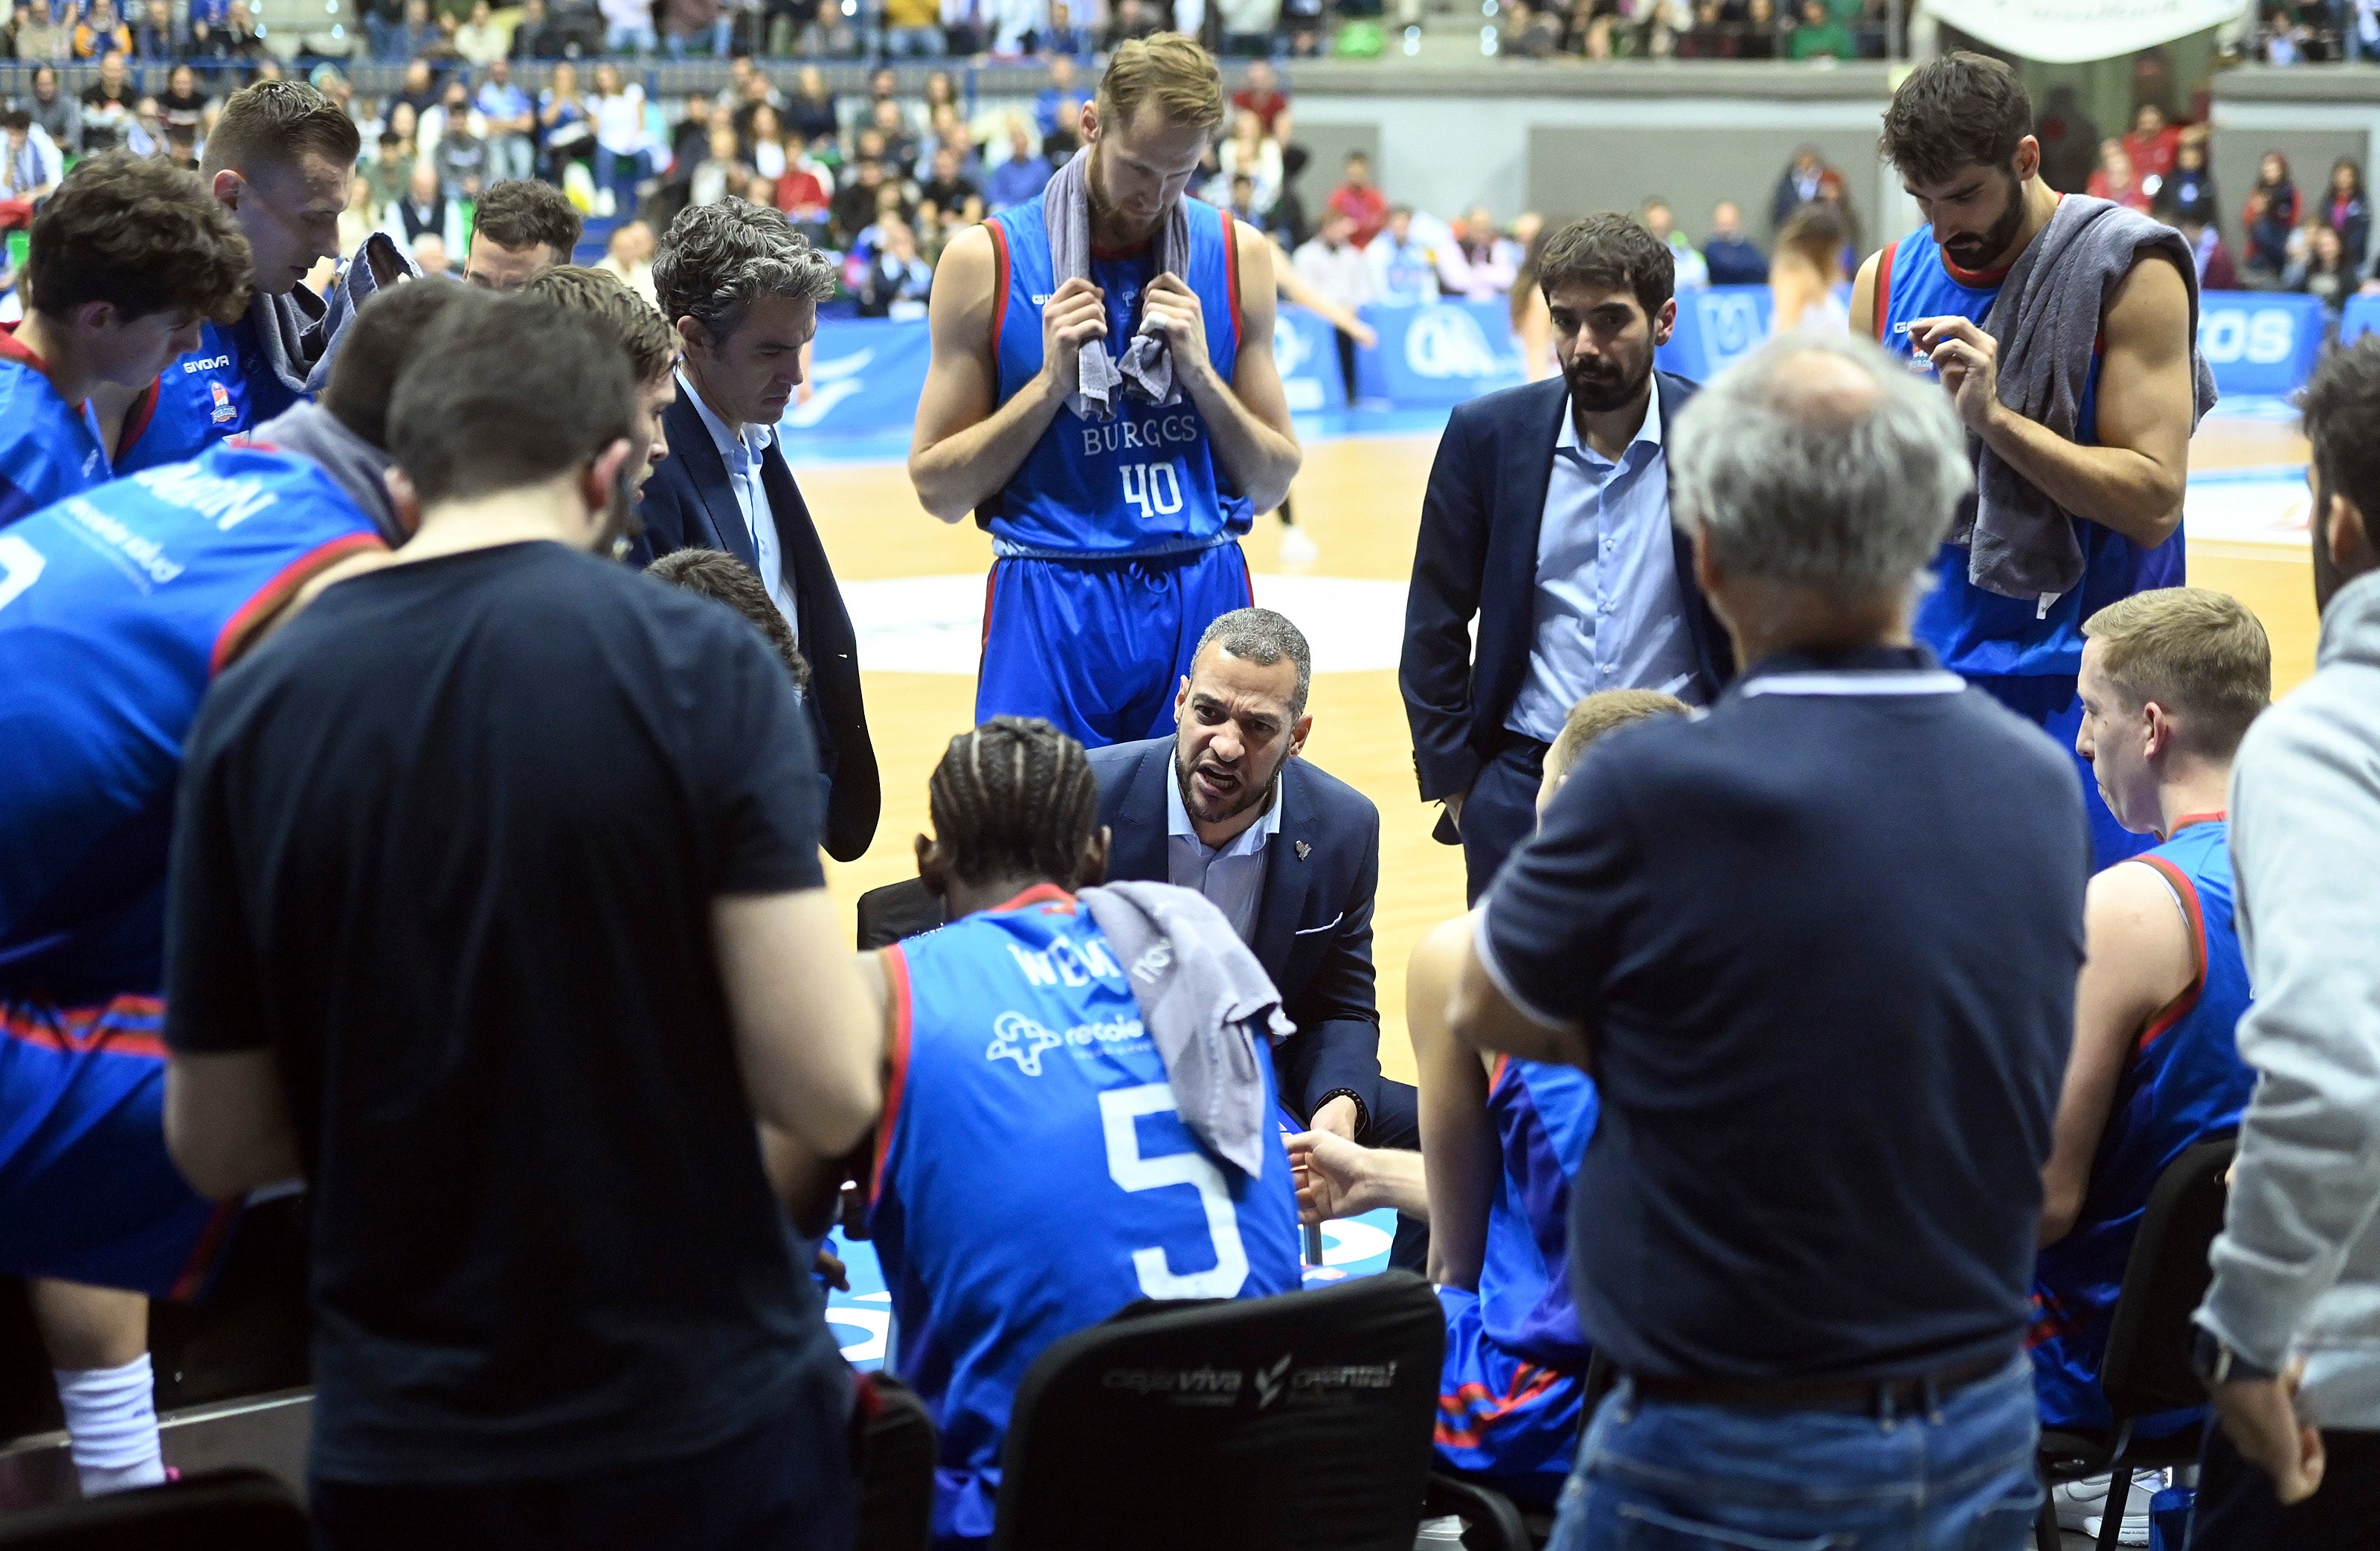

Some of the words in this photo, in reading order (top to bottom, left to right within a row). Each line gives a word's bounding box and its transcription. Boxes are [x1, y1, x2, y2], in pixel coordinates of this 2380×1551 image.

[183, 355, 230, 373] GIVOVA
[1119, 462, 1184, 518] 40
[1099, 1082, 1250, 1300] 5
